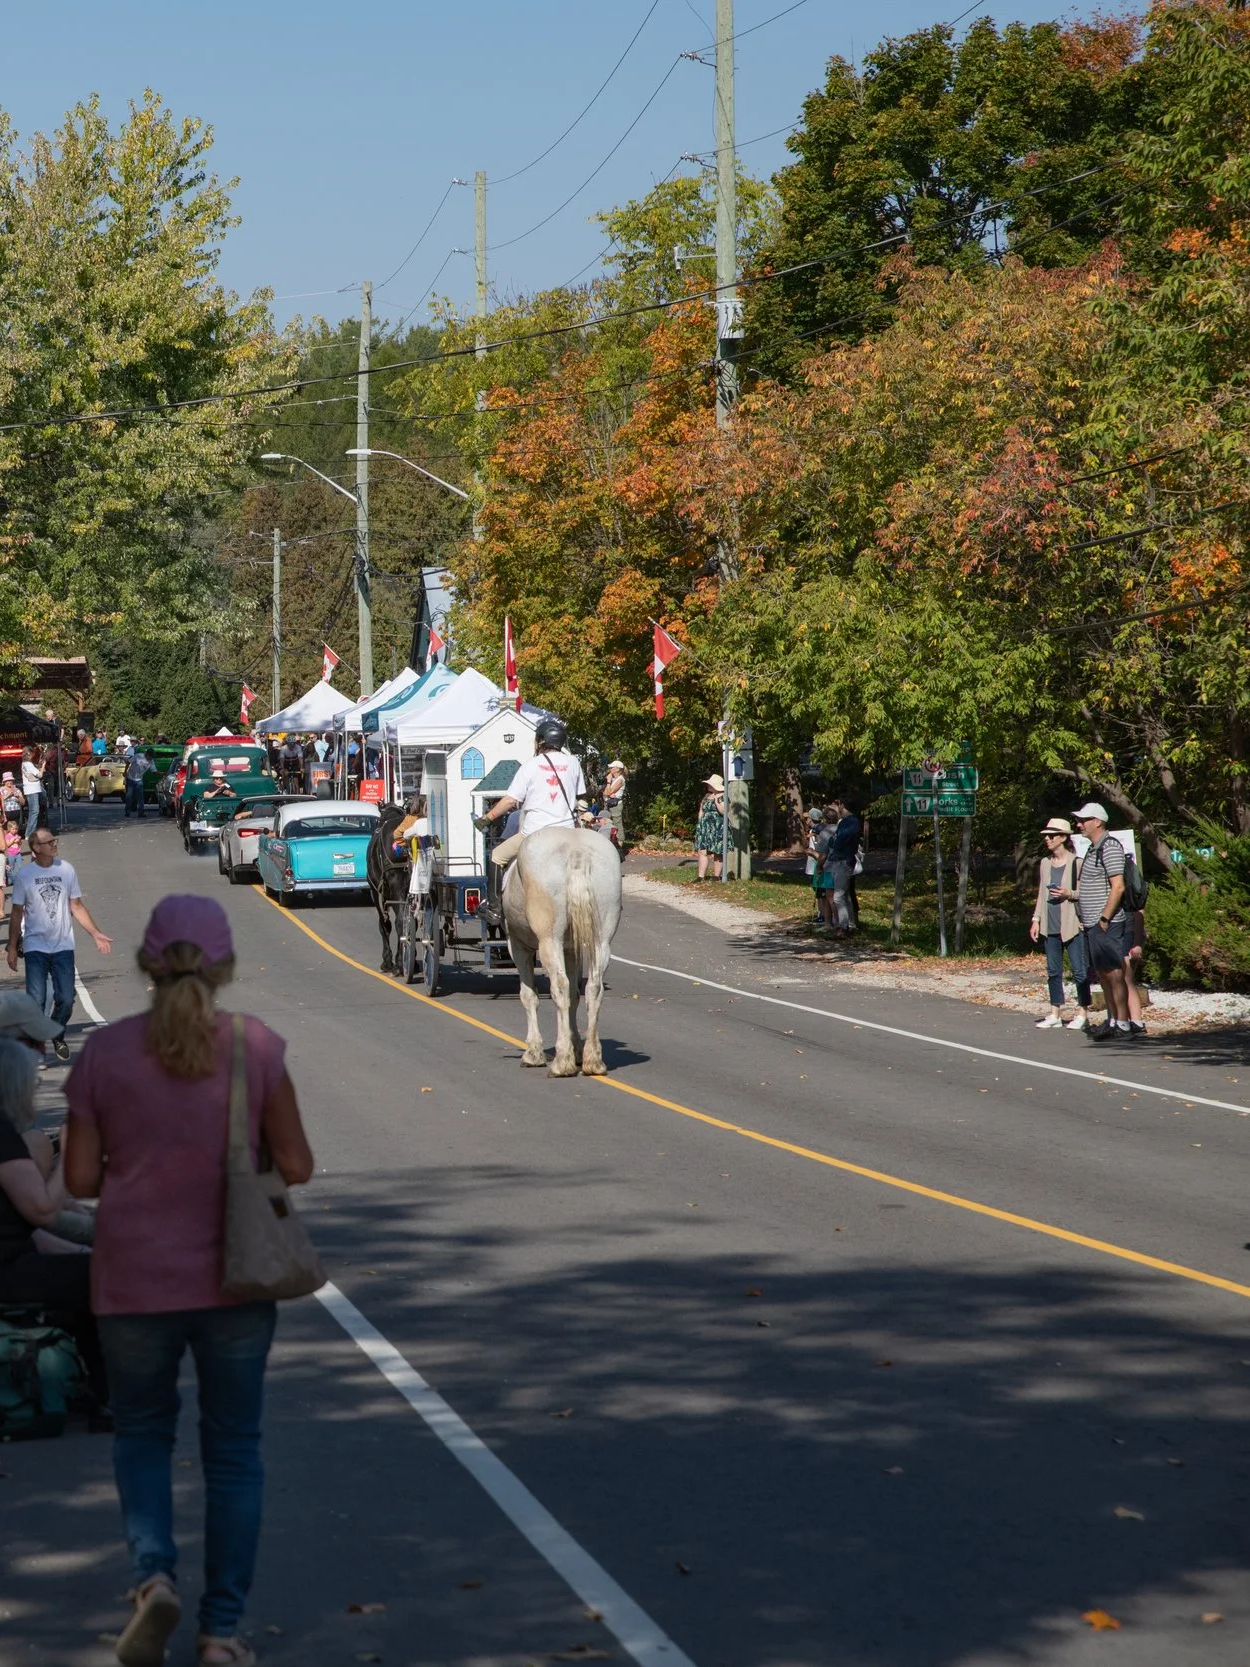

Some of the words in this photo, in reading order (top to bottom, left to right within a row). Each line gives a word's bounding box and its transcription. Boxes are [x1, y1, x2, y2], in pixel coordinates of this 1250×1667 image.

[913, 774, 921, 784] 11
[946, 771, 965, 779] ush
[918, 799, 927, 809] 11
[35, 876, 62, 885] BELFOUNTAIN
